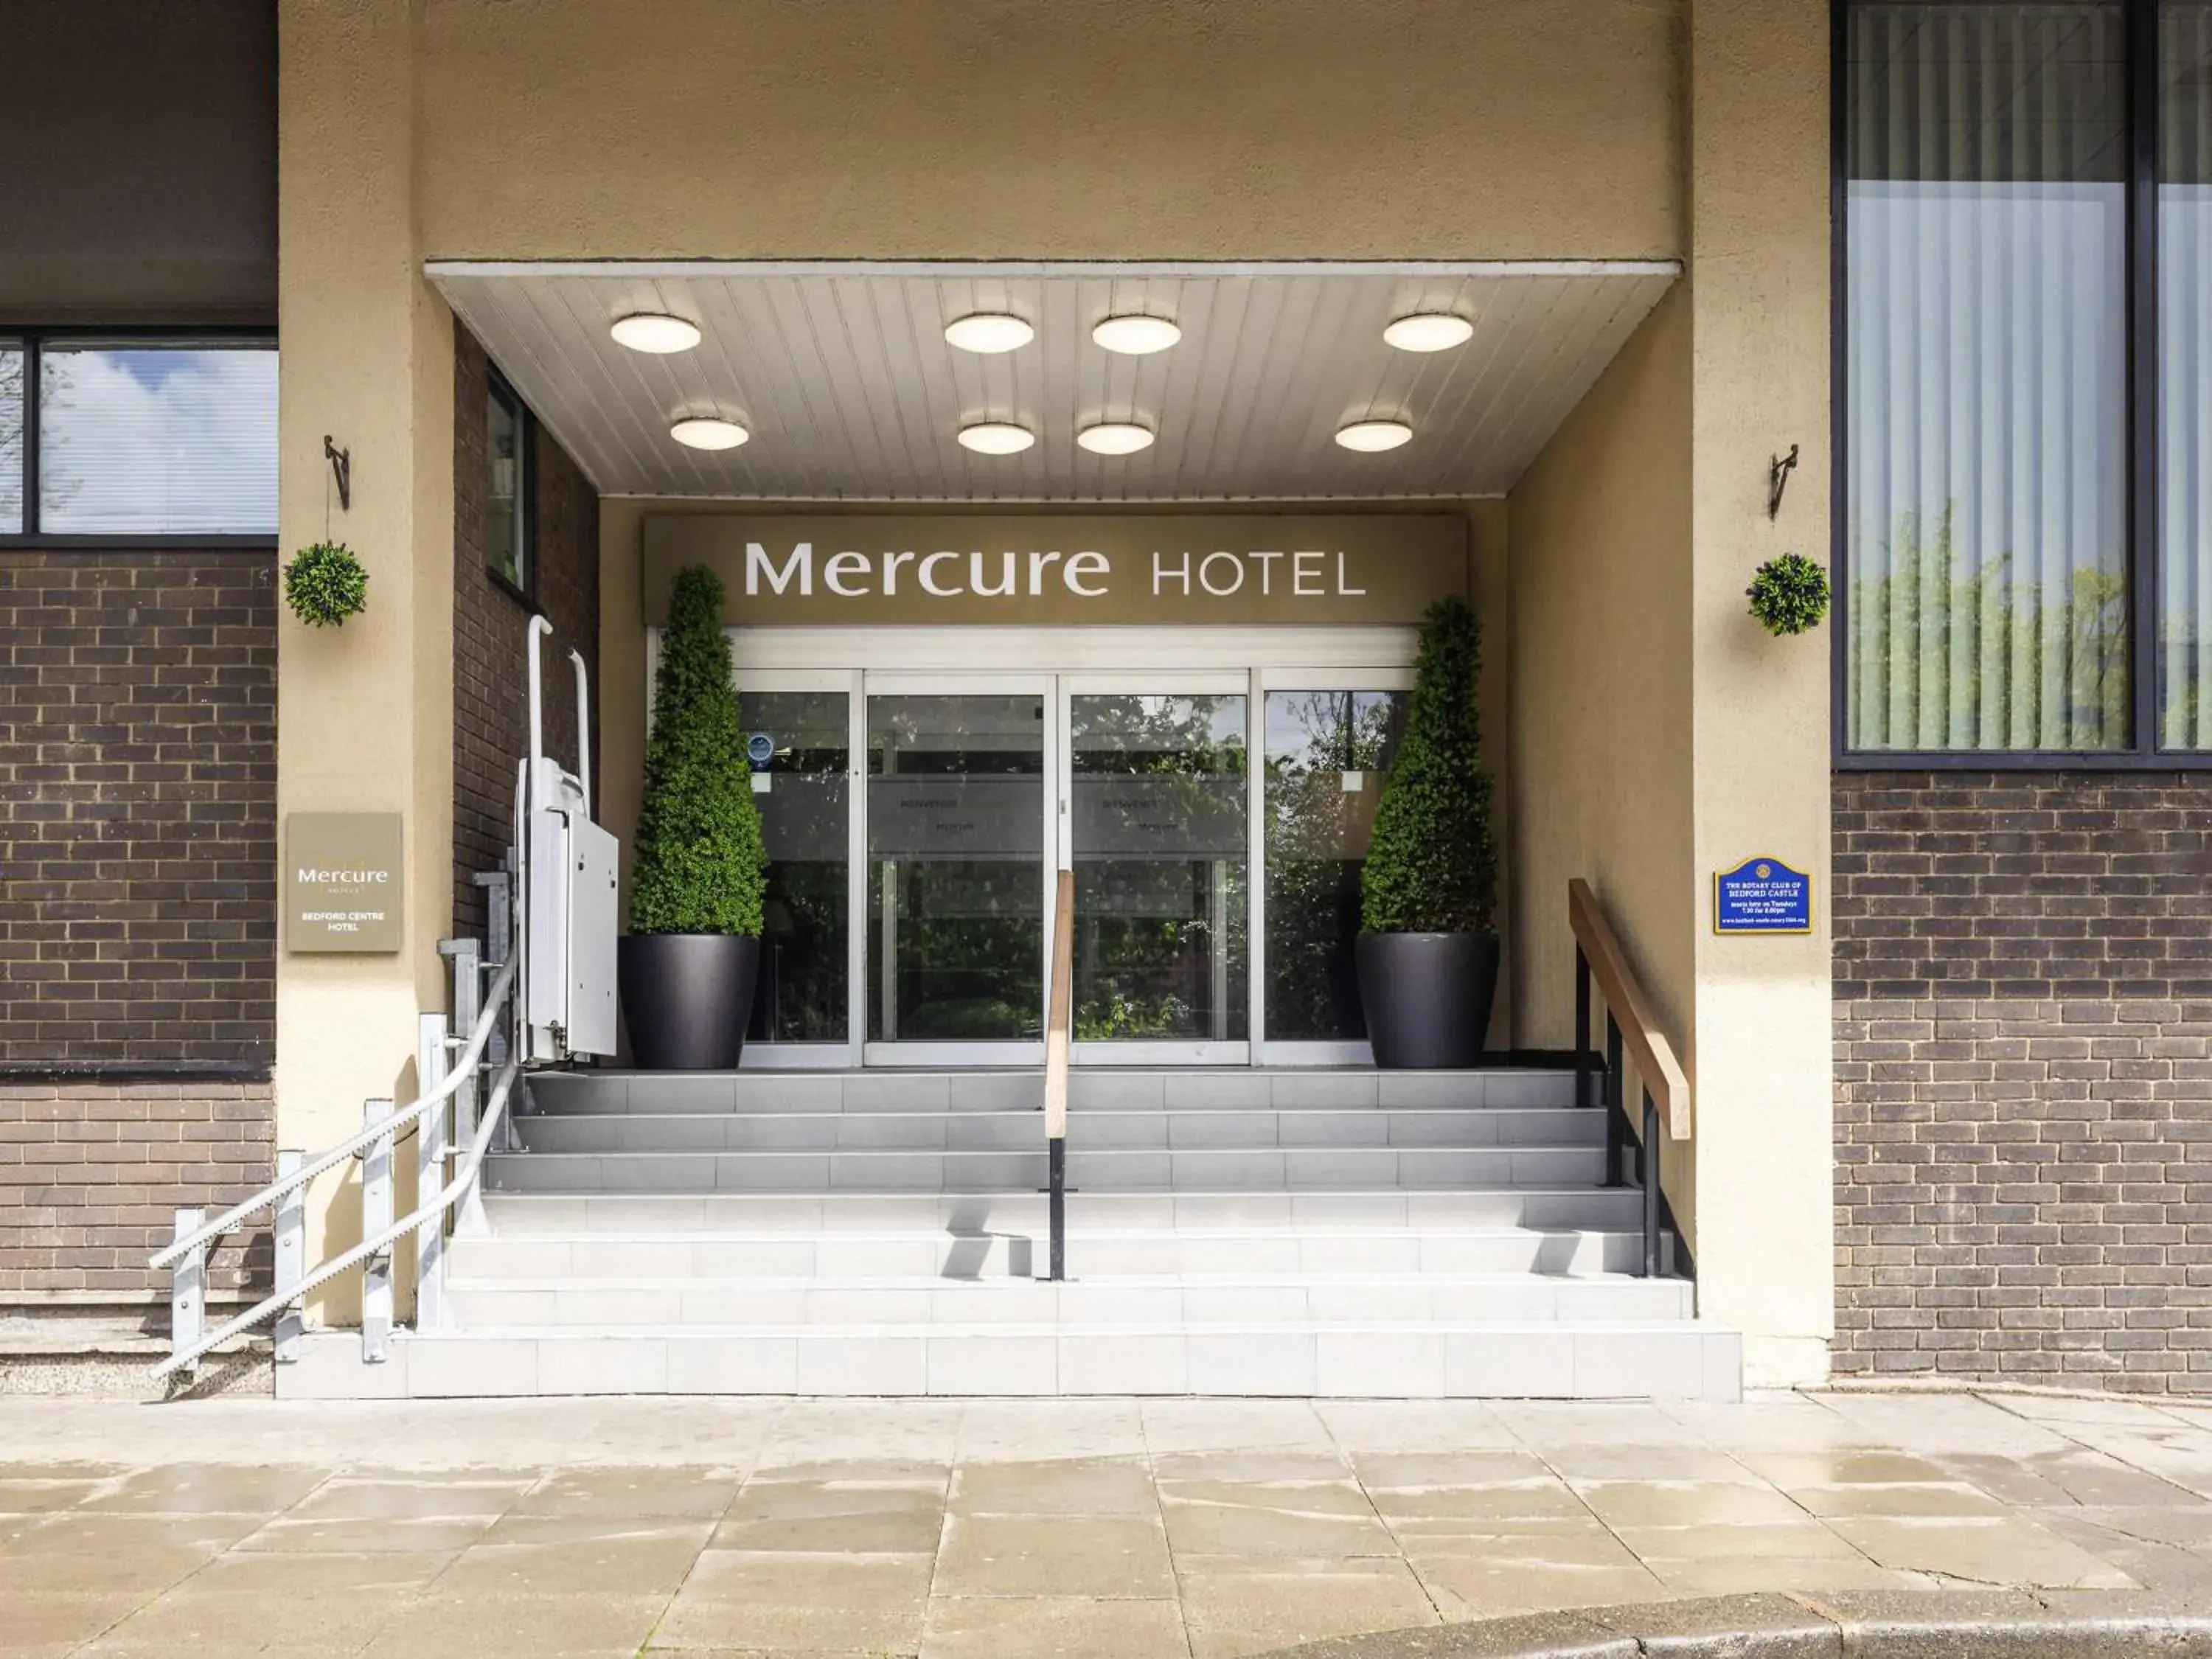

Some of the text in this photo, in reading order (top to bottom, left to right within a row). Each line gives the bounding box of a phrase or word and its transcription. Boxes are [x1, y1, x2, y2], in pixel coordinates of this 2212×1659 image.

[745, 541, 1367, 597] Mercure HOTEL
[298, 868, 387, 883] Mercure
[302, 912, 385, 921] BEDFORD CENTRE
[327, 923, 359, 931] HOTEL
